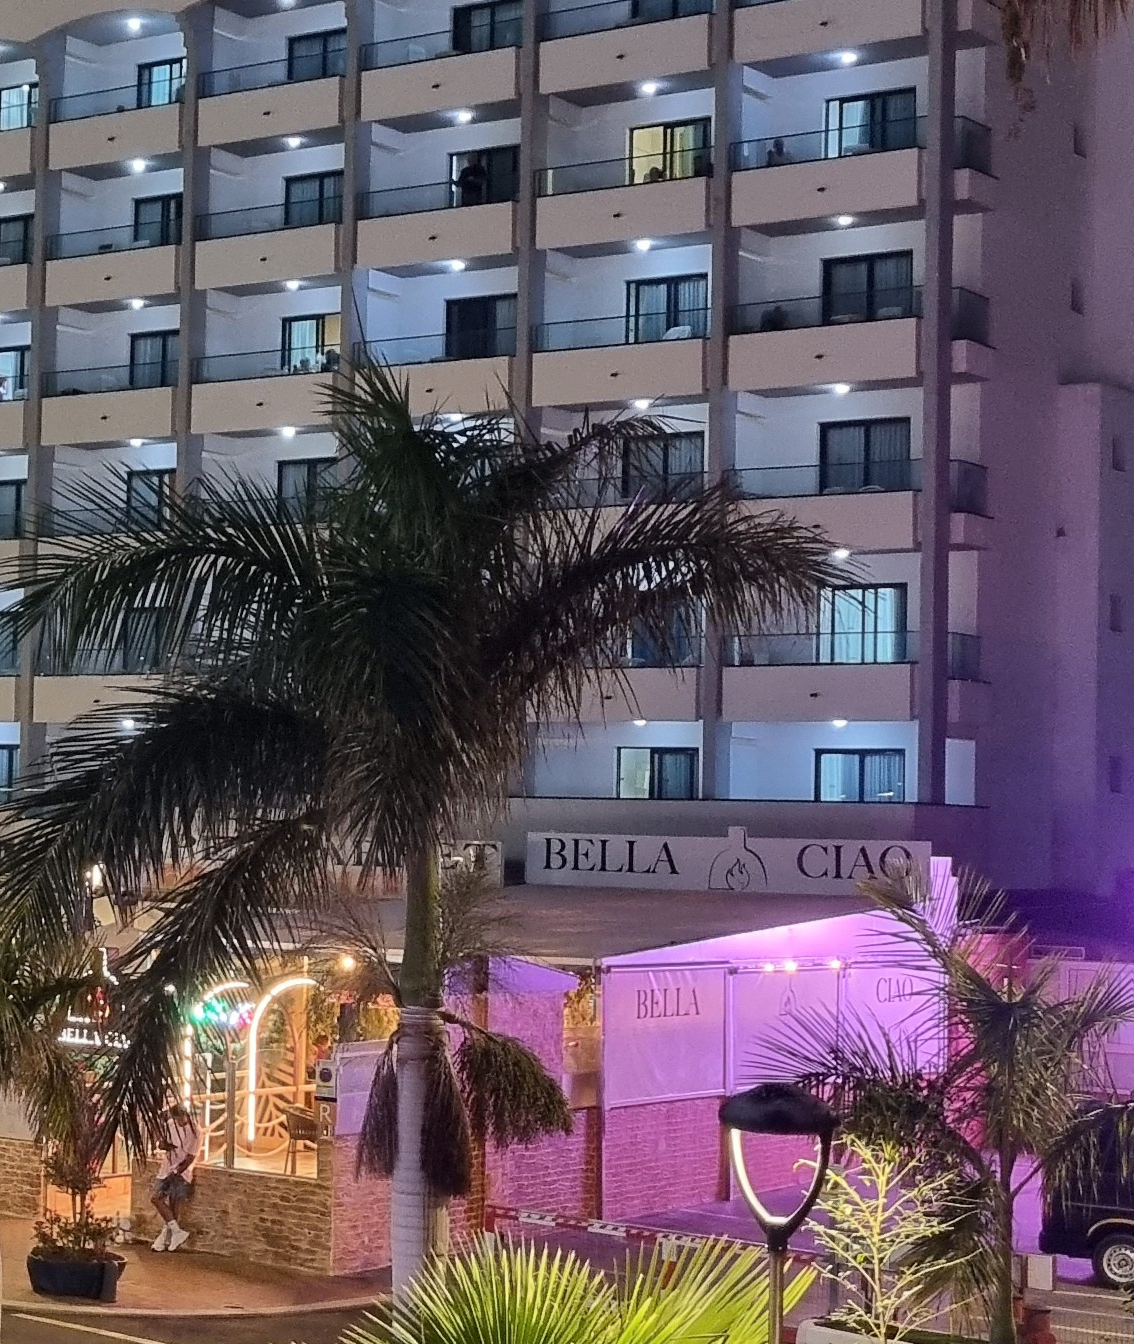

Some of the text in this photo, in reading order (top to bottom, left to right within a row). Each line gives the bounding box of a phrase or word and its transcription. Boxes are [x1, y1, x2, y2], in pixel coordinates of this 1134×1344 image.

[543, 837, 680, 875] BELLA
[796, 843, 914, 880] CIAO
[636, 977, 914, 1020] BELLA CIAO
